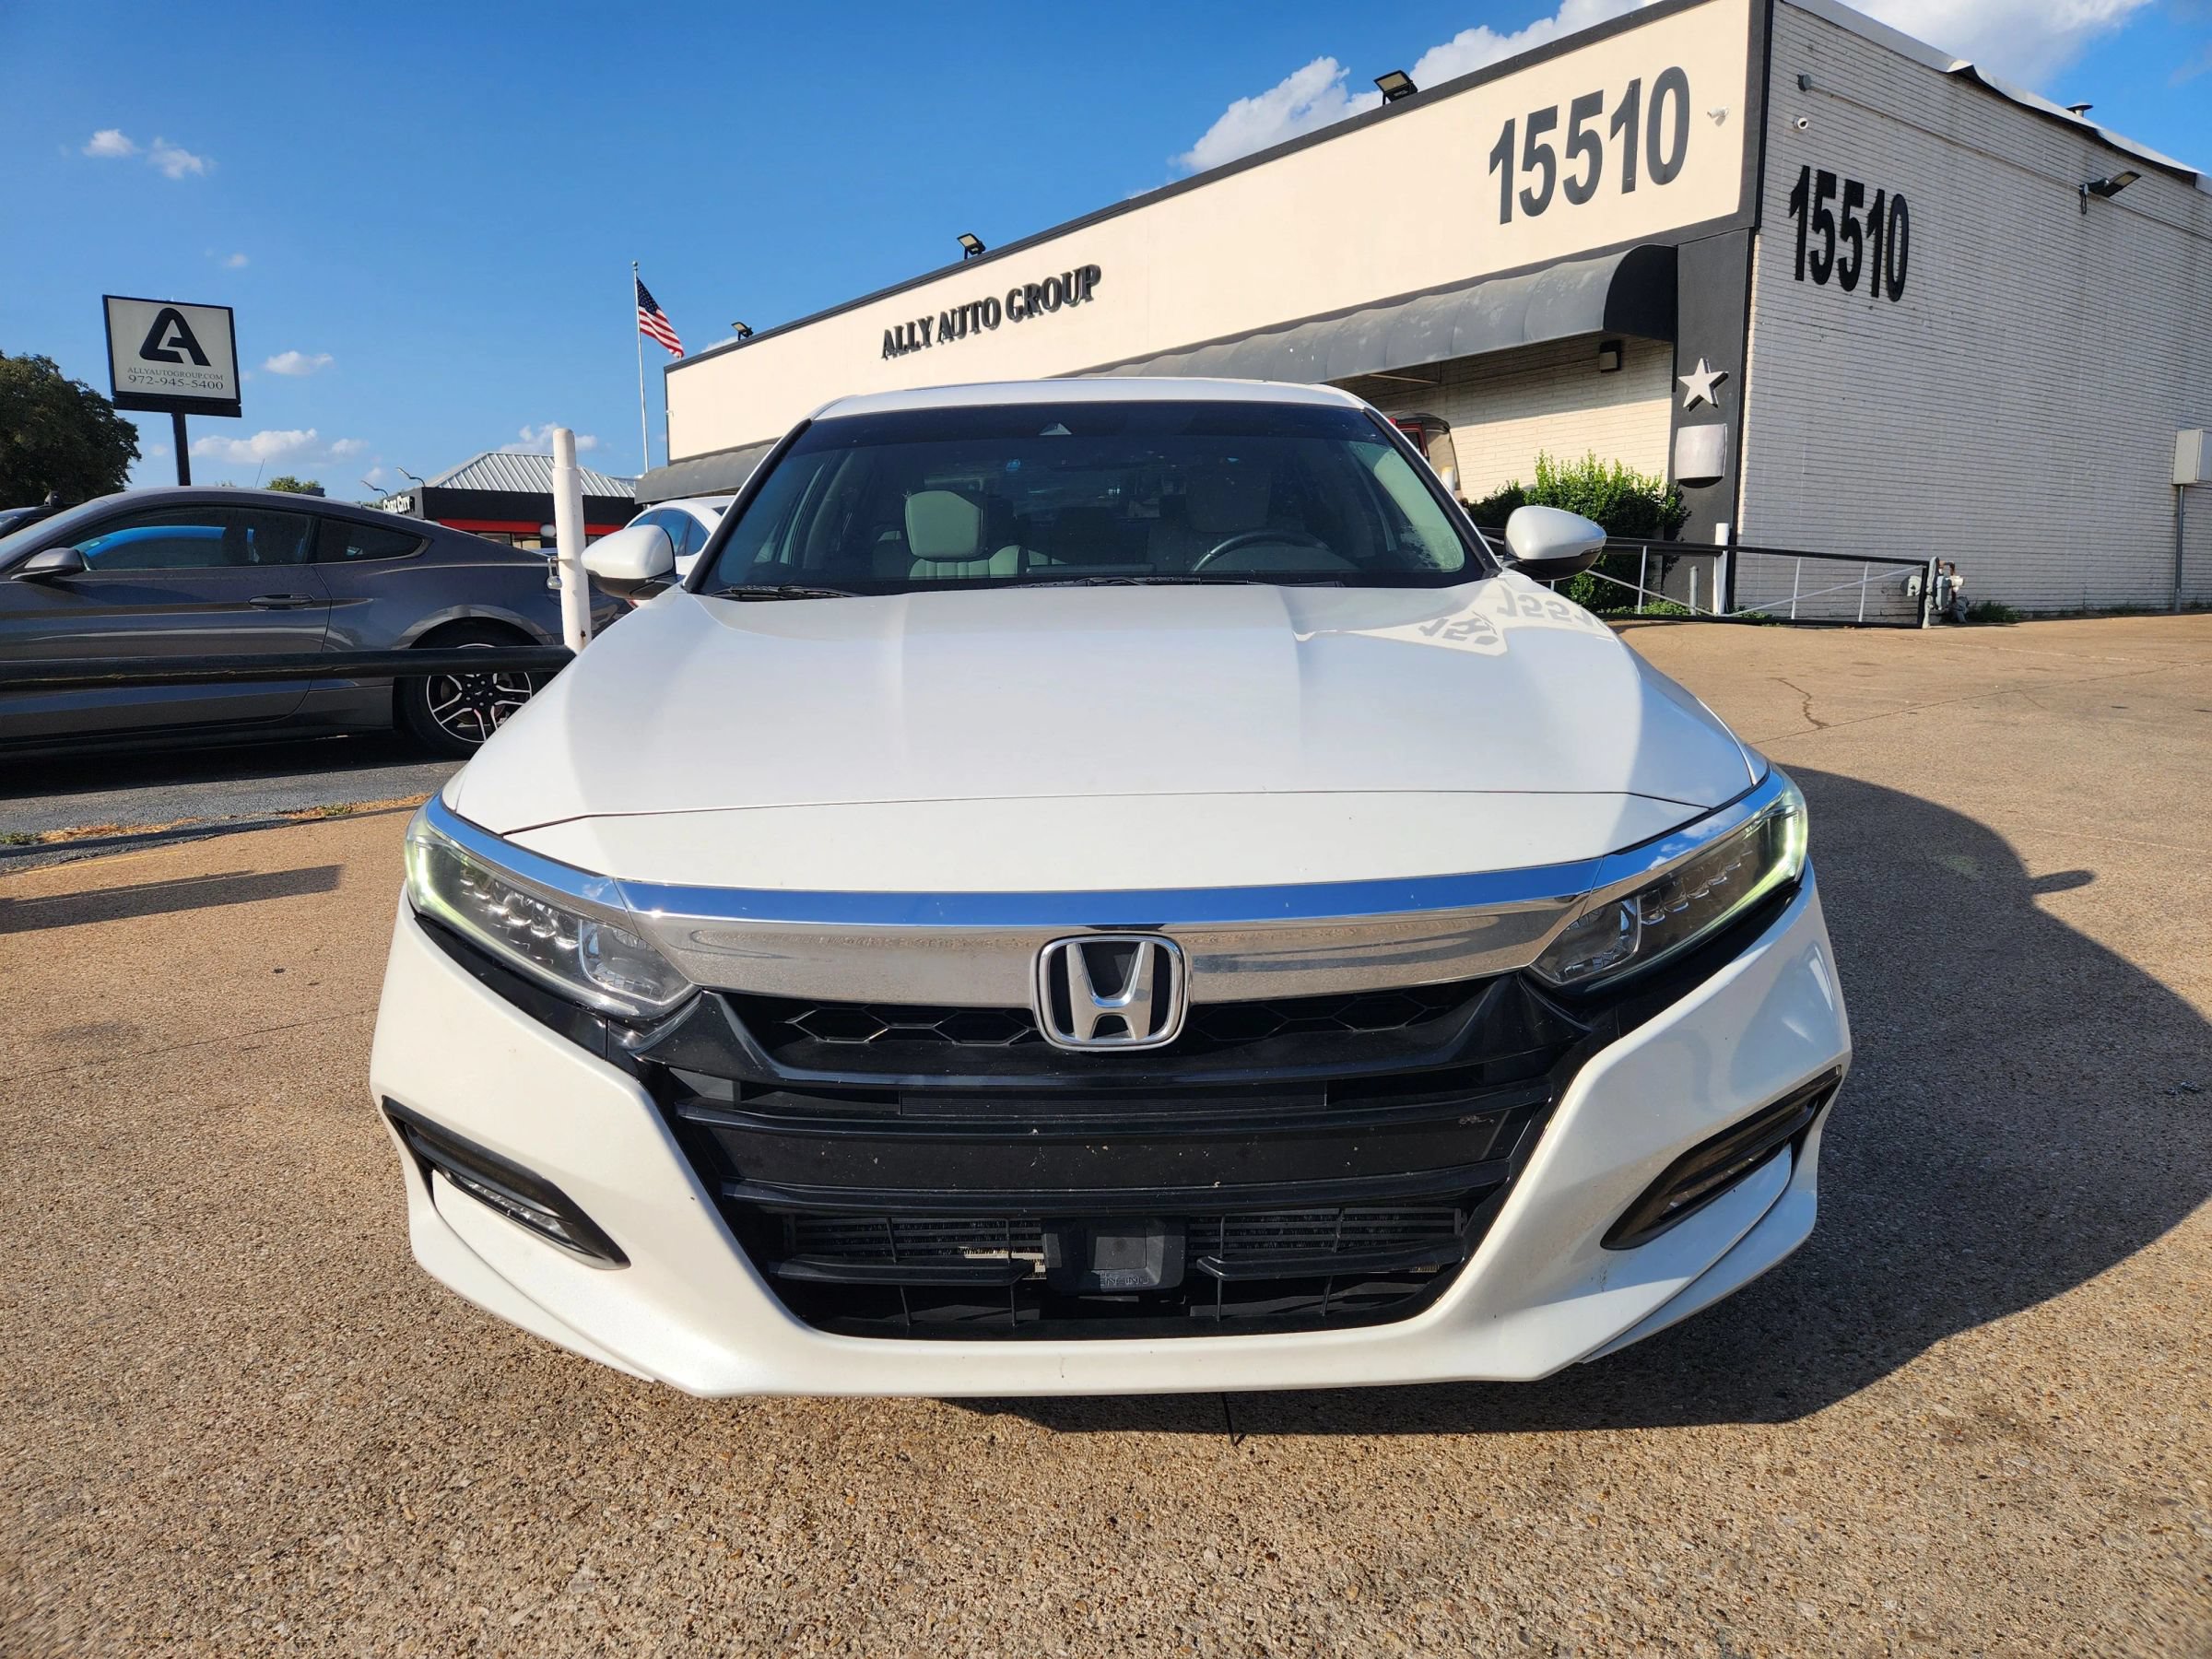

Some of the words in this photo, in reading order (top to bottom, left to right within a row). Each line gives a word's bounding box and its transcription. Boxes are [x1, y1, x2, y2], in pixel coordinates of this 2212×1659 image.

[1488, 66, 1689, 225] 15510
[1789, 164, 1910, 302] 15510
[881, 316, 935, 360] ALLY
[936, 296, 1001, 345] AUTO
[1006, 264, 1101, 323] GROUP
[127, 367, 224, 381] ALLYAUTOGROUP.COM
[128, 374, 224, 390] 972-945-5400
